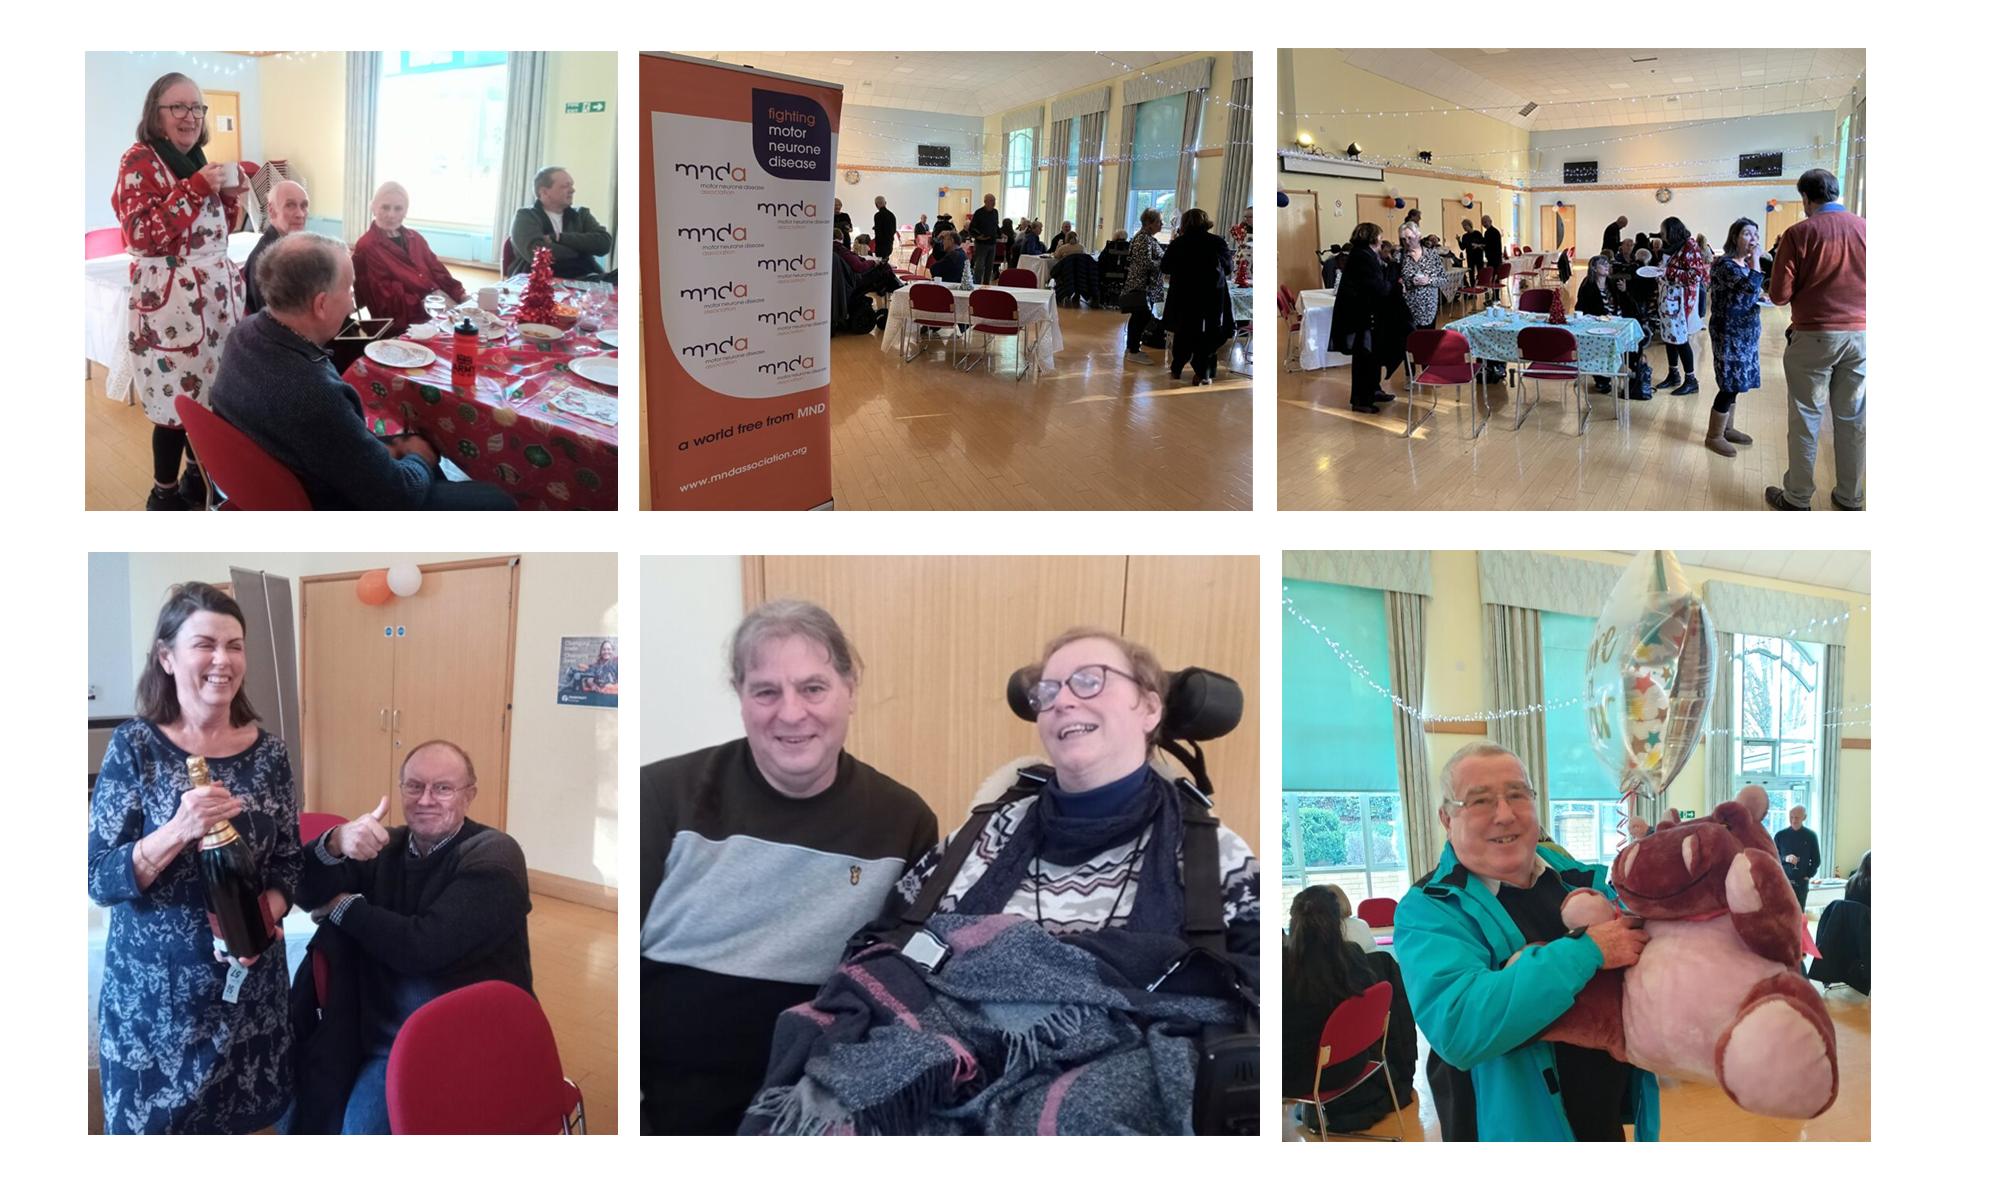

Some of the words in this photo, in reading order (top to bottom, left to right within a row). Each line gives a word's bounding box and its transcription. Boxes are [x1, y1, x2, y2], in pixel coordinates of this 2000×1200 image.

[769, 108, 816, 127] fighting
[769, 126, 807, 138] motor
[769, 142, 821, 155] neurone
[675, 162, 747, 182] mnda
[769, 156, 817, 169] disease
[757, 200, 817, 217] mnda
[678, 223, 747, 242] mnda
[758, 254, 816, 272] mnda
[680, 281, 747, 302] mnda
[758, 306, 815, 325] mnda
[682, 335, 748, 357] mnda
[453, 363, 476, 373] ARMY
[758, 355, 814, 374] mnda
[678, 441, 689, 451] a
[693, 426, 734, 446] world
[737, 423, 763, 435] free
[766, 412, 795, 427] from
[797, 403, 826, 418] MND
[679, 446, 807, 493] www.mndassociation.org
